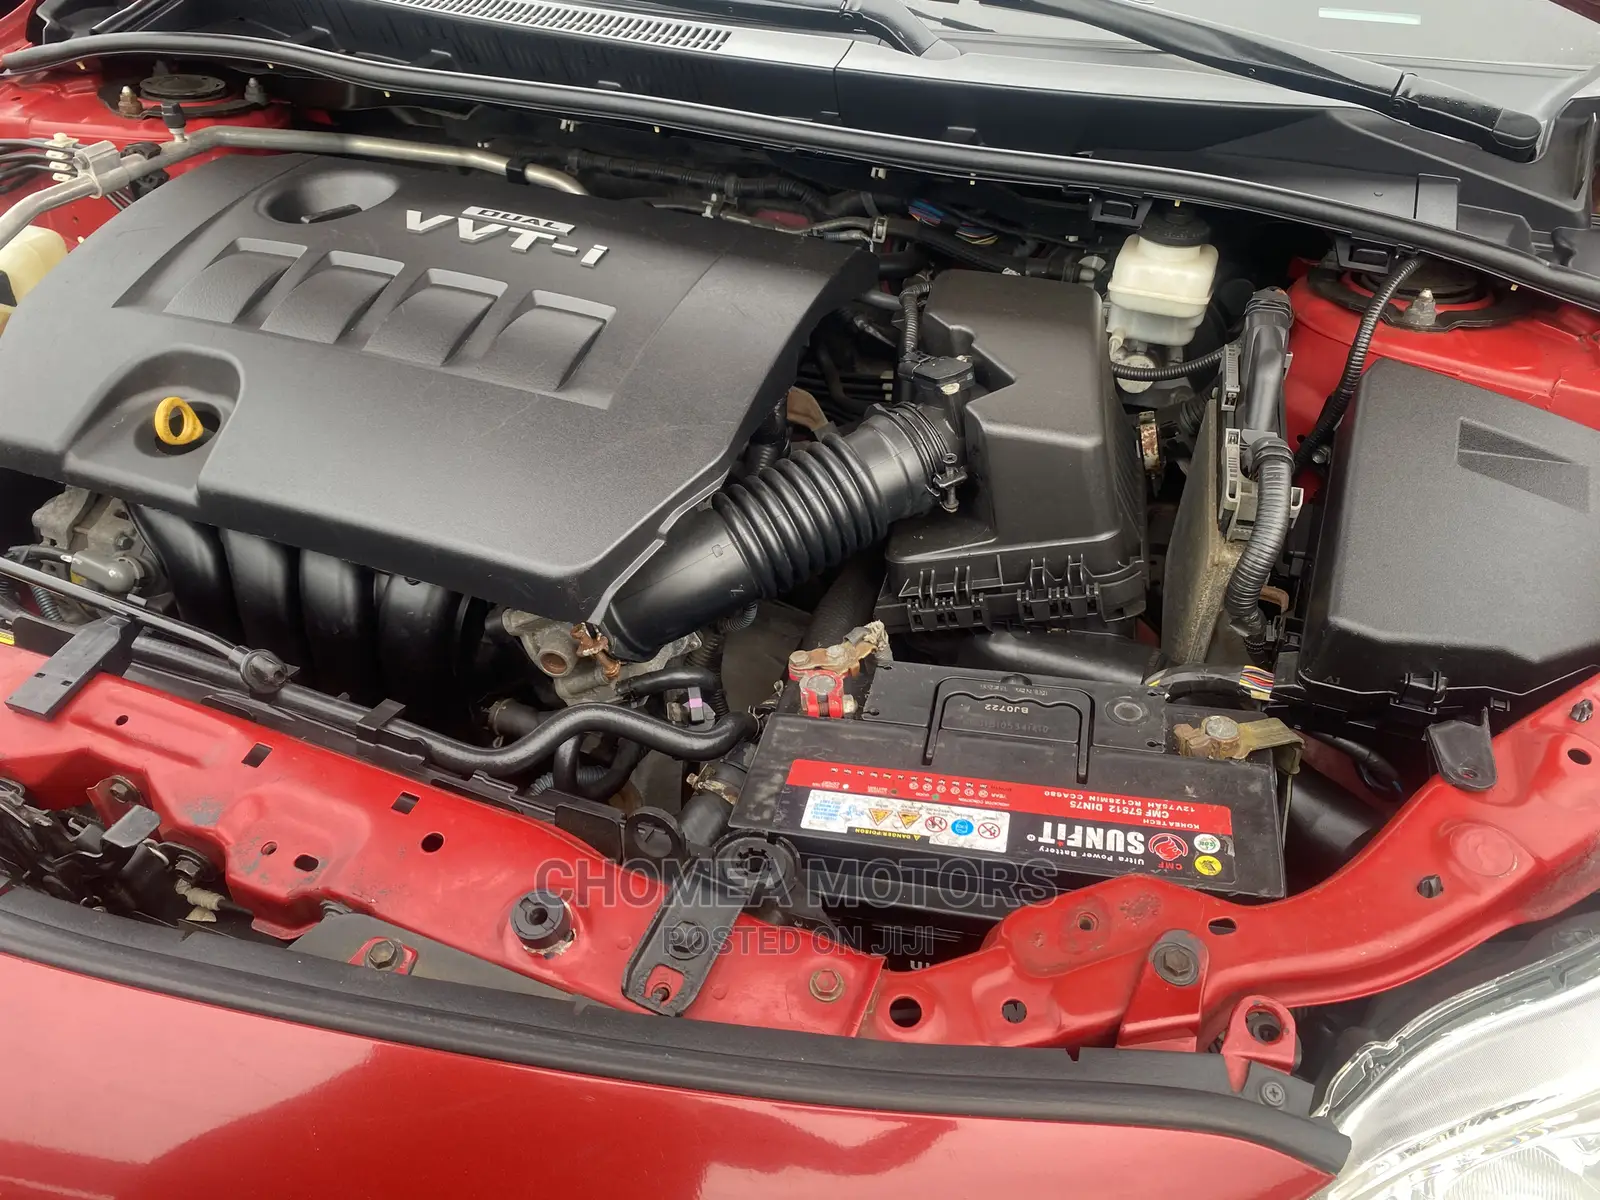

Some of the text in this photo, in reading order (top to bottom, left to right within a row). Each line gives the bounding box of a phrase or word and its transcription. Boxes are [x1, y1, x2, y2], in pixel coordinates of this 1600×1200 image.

[477, 209, 562, 228] DUAL
[406, 209, 609, 268] VVT-i
[984, 703, 1029, 714] BJ0722
[1069, 801, 1169, 818] CMF 57512 DIN75
[1142, 818, 1167, 828] TECH
[1038, 845, 1144, 865] Ultra Power Battery
[1157, 862, 1182, 870] CMF
